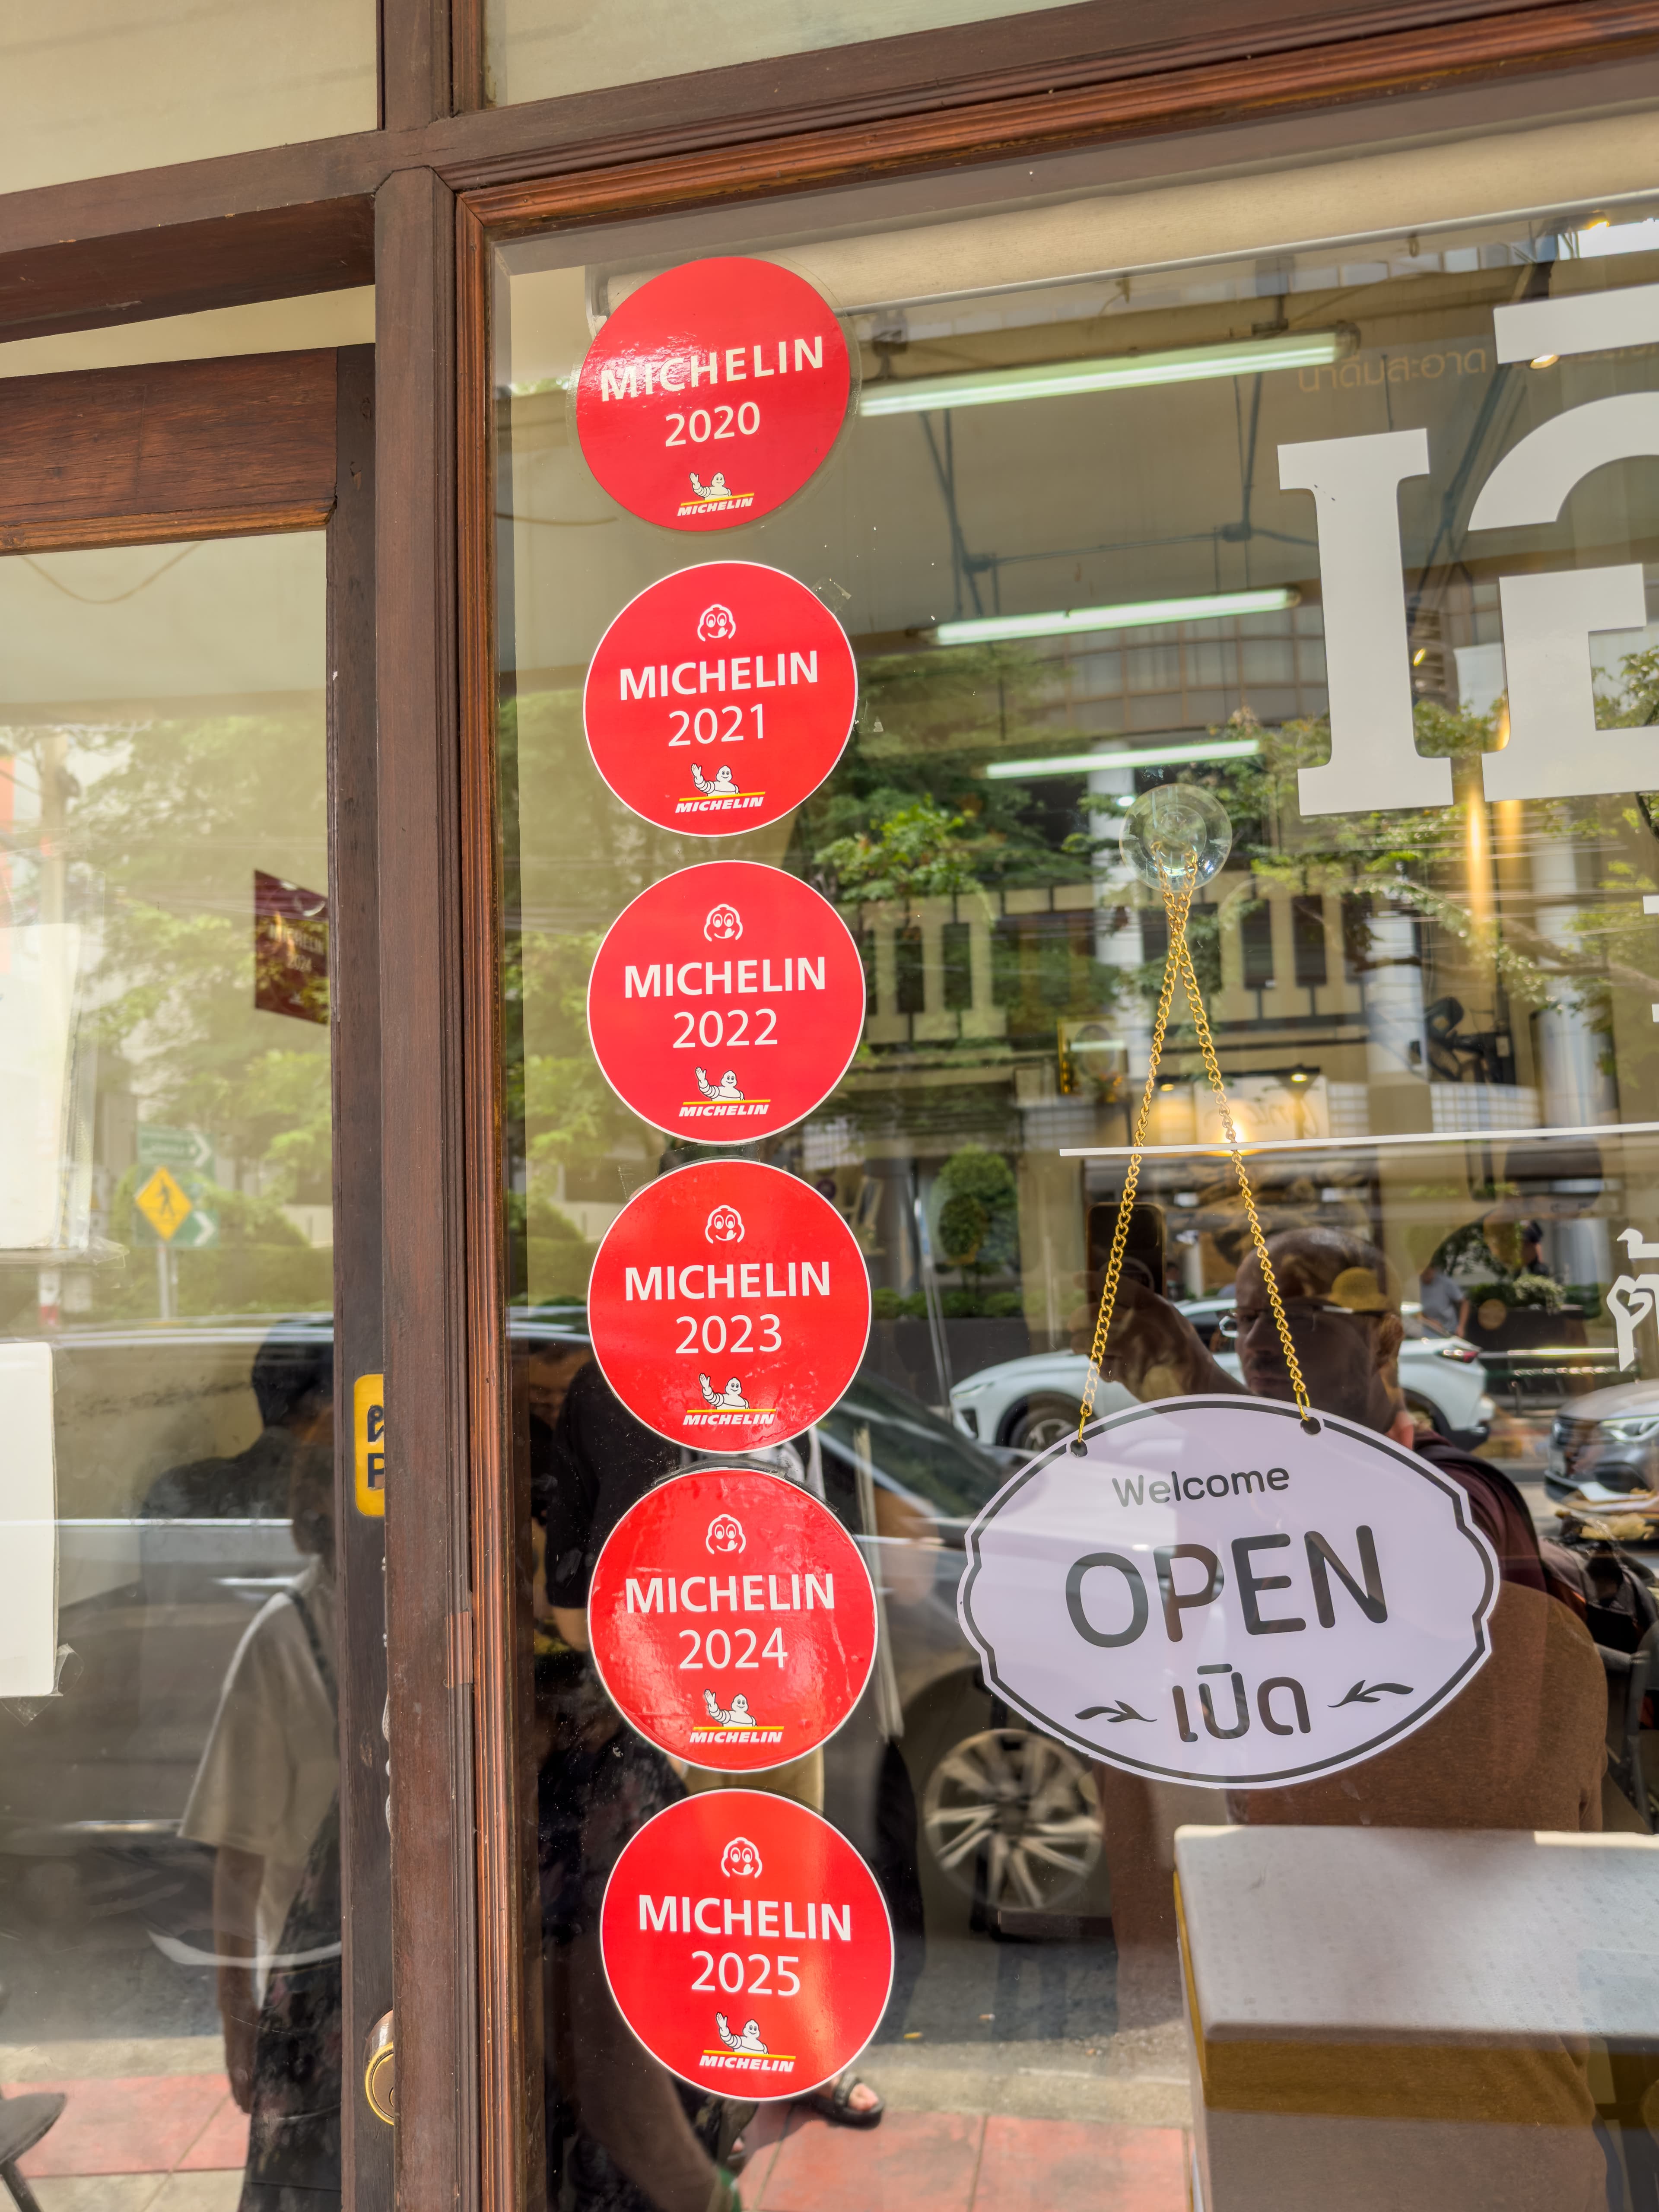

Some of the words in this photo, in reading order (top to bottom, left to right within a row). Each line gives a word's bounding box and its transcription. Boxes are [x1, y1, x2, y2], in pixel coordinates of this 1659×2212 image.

[601, 336, 823, 402] MICHELIN
[666, 402, 760, 447] 2020
[677, 497, 754, 516] MICHELIN
[620, 651, 817, 700] MICHELIN
[669, 704, 763, 747] 2021
[675, 797, 764, 813] MICHELIN
[625, 957, 825, 998] MICHELIN
[673, 1008, 778, 1048] 2022
[679, 1104, 769, 1117] MICHELIN
[626, 1261, 830, 1301] MICHELIN
[676, 1314, 782, 1354] 2023
[683, 1414, 775, 1425] MICHELIN
[1112, 1468, 1290, 1507] Welcome
[626, 1573, 835, 1615] MICHELIN
[1065, 1525, 1388, 1648] OPEN
[679, 1627, 788, 1669] 2024
[1172, 1663, 1311, 1743] เปิด
[689, 1732, 783, 1743] MICHELIN
[639, 1894, 851, 1941] MICHELIN
[691, 1951, 801, 1996] 2025
[699, 2055, 795, 2072] MICHELIN
